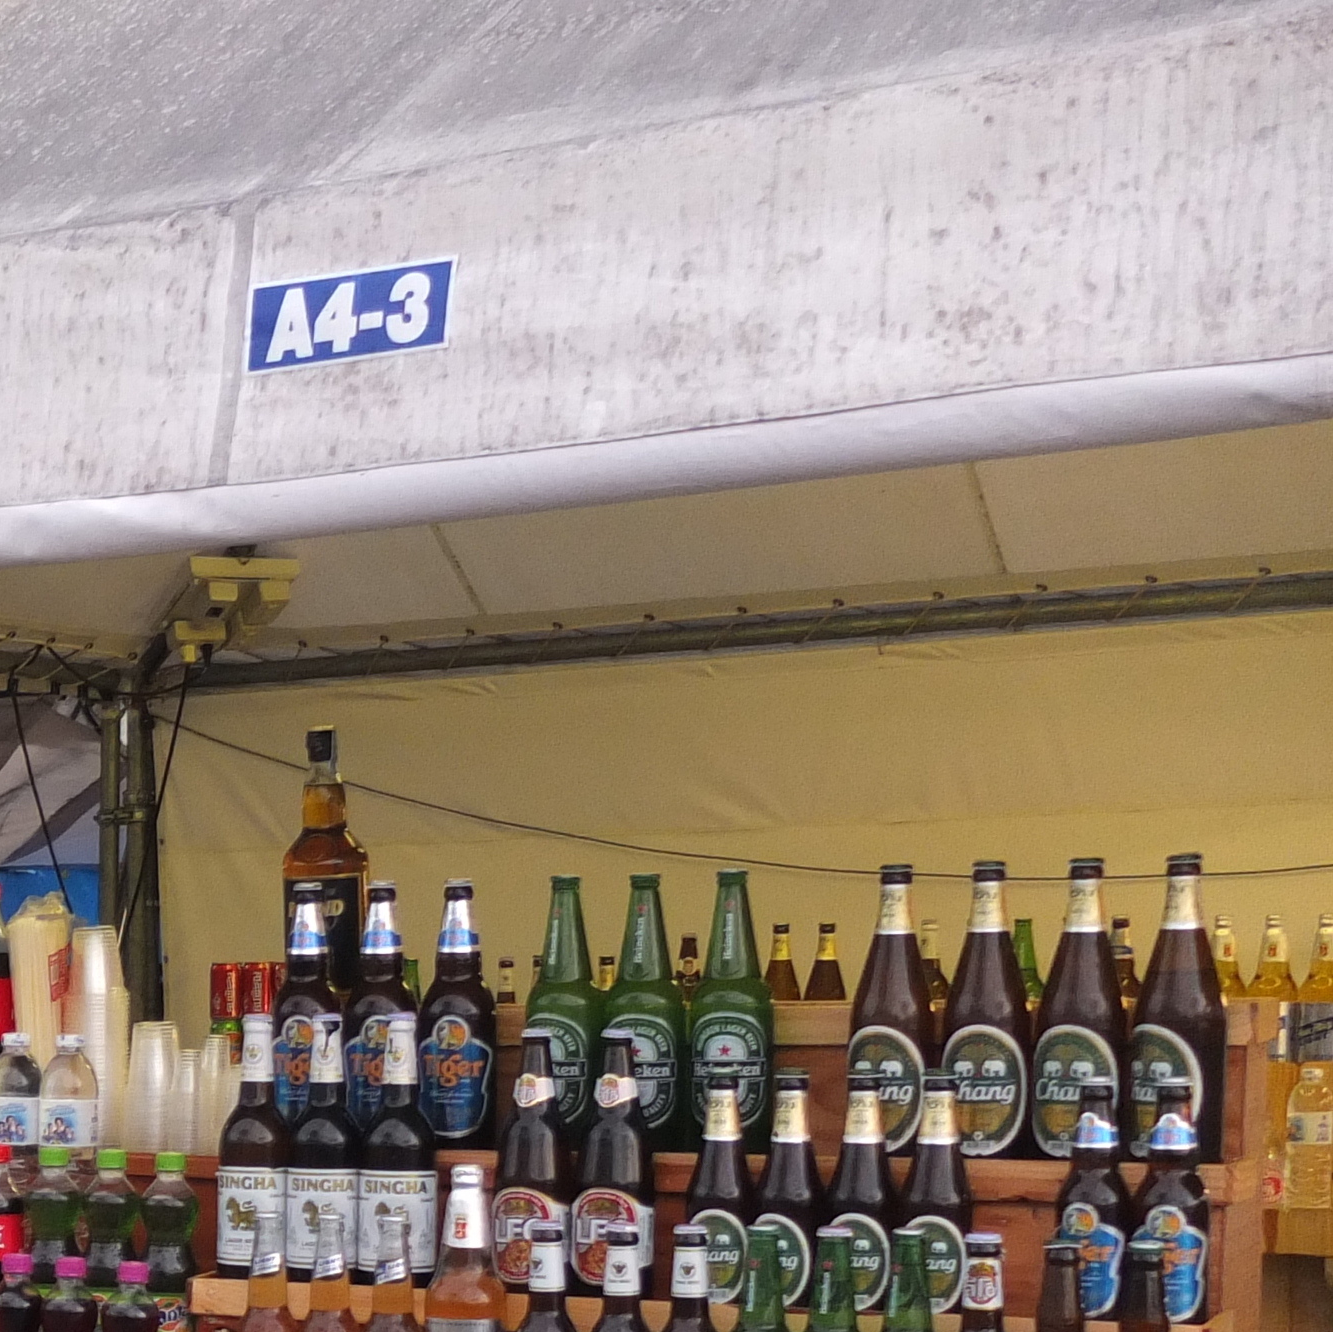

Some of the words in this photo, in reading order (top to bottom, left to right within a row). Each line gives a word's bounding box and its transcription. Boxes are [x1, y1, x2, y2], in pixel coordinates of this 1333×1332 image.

[265, 272, 431, 363] A4-3
[422, 1053, 485, 1087] Tiger
[957, 1078, 1016, 1104] hang
[219, 1176, 276, 1191] SINGHA
[291, 1177, 354, 1192] SINGHA
[364, 1179, 428, 1195] SINGHA
